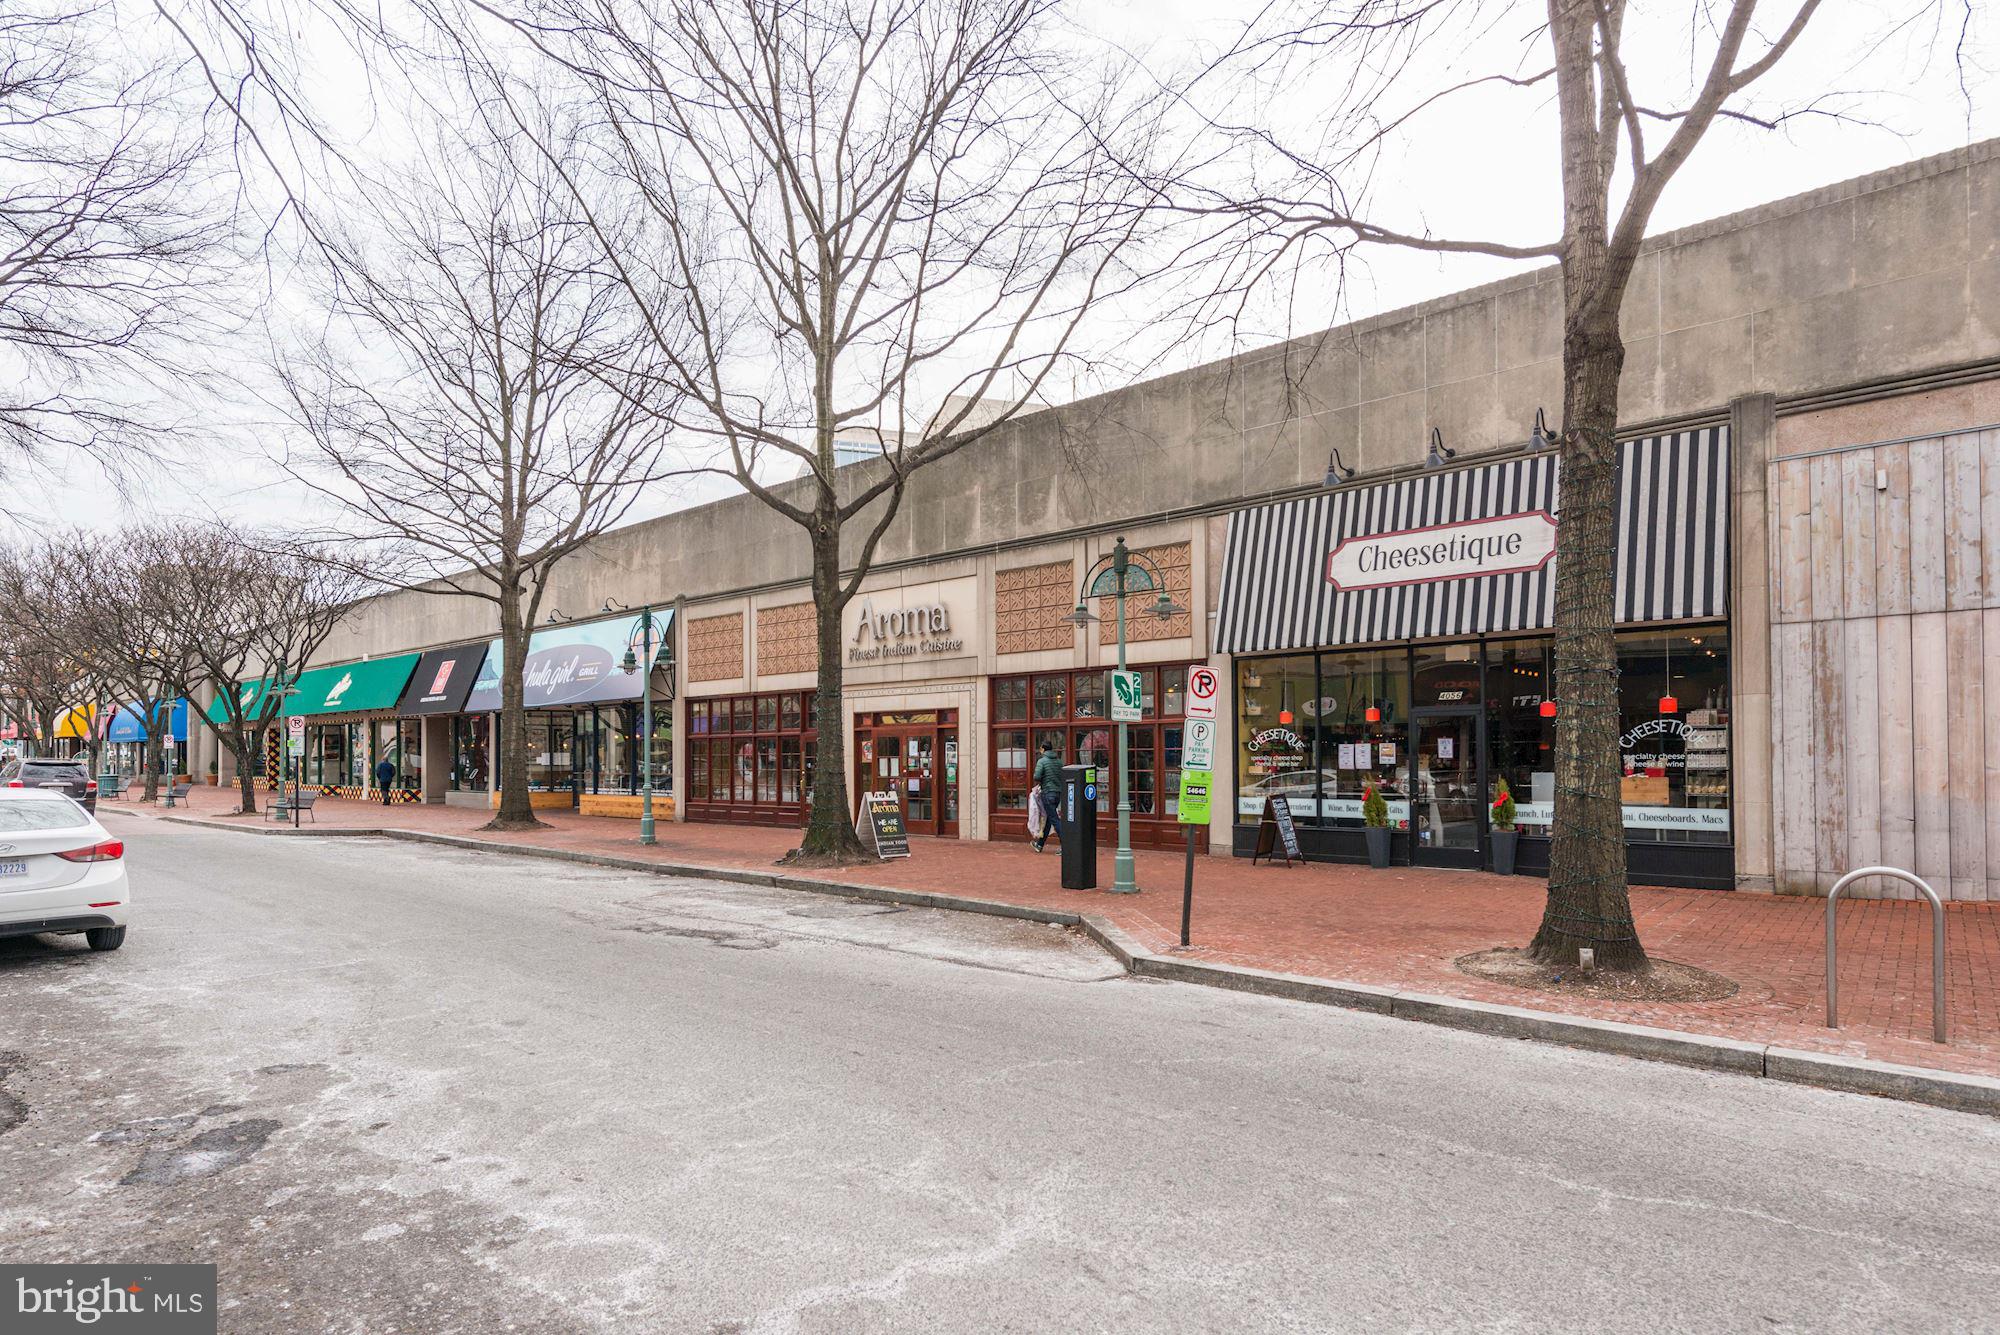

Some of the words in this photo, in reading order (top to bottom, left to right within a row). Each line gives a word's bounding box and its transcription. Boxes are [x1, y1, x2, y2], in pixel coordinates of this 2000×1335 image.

[1358, 532, 1522, 573] Cheesetique
[852, 597, 950, 645] Aroma
[848, 645, 880, 662] Finest
[882, 641, 917, 658] Indian
[919, 637, 963, 654] Cuisine
[525, 659, 551, 687] hula
[579, 667, 599, 676] GRILL
[1133, 676, 1141, 689] 2
[1440, 692, 1462, 700] 4056
[1248, 728, 1305, 751] CHEESETIQUE
[1619, 719, 1709, 748] CHEESETIQUE
[1188, 746, 1210, 754] PARKING
[1623, 752, 1657, 761] specialty
[1658, 752, 1685, 760] cheese
[1687, 753, 1706, 762] shop
[872, 802, 899, 813] Aroma
[1389, 806, 1404, 814] Gifts
[1702, 814, 1724, 824] Macs
